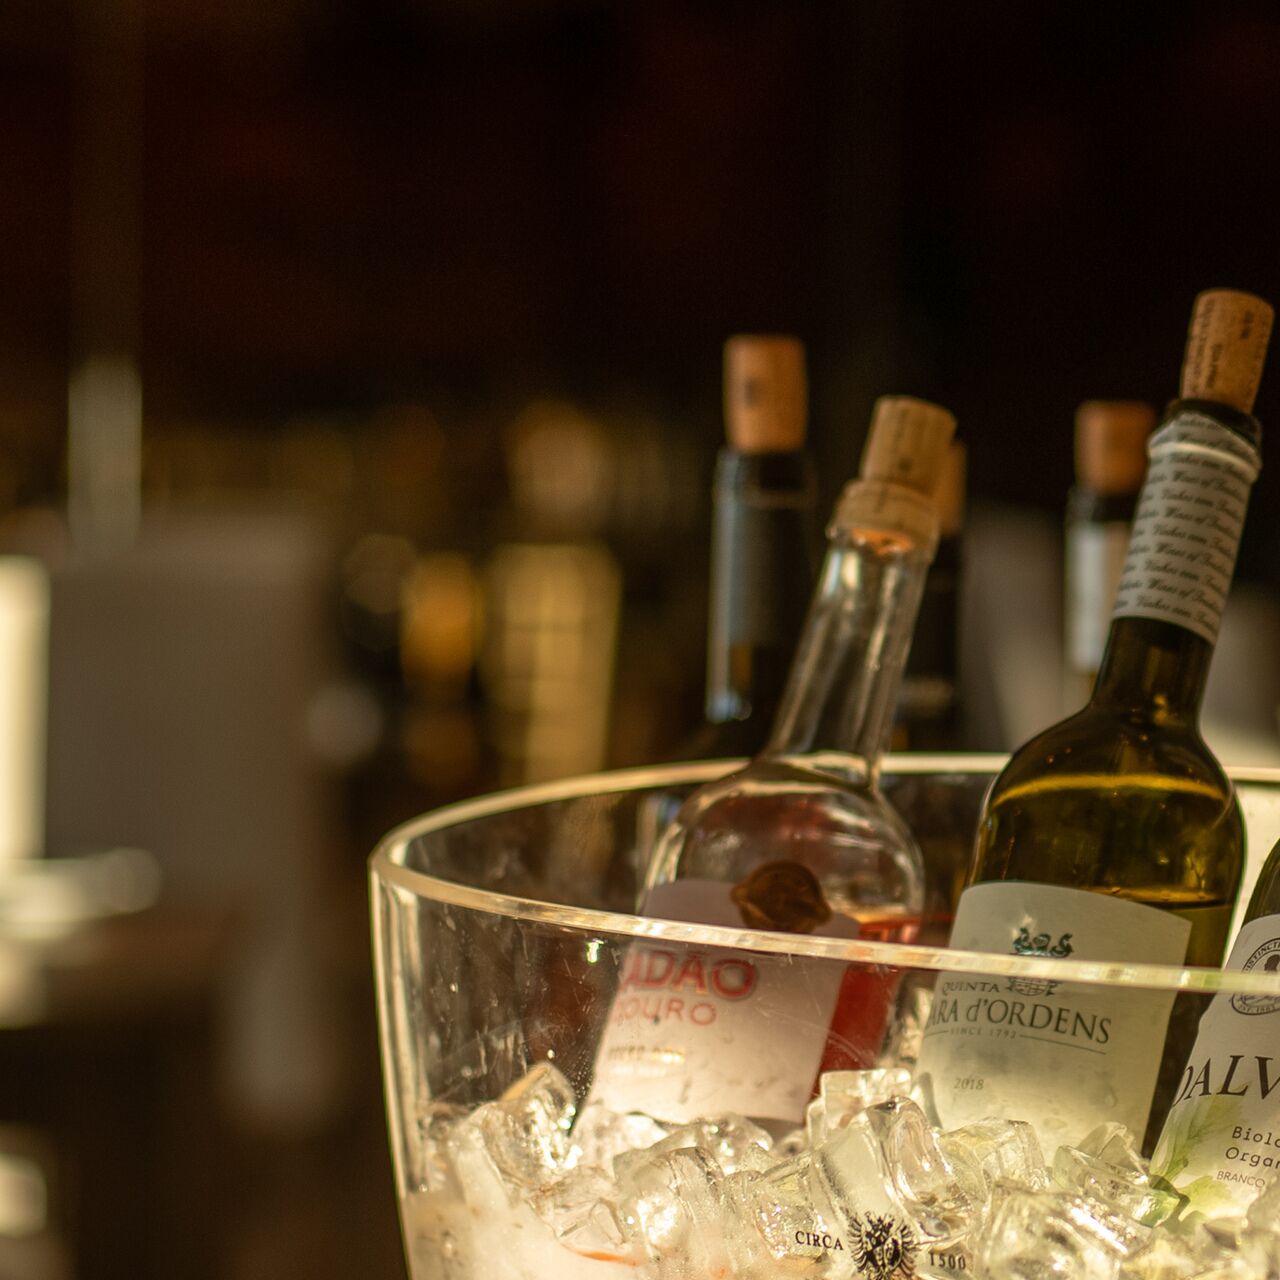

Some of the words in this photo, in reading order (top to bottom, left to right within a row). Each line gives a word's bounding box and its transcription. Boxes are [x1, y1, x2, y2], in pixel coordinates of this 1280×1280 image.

[942, 981, 1000, 996] QUINTA
[611, 995, 717, 1026] OURO
[953, 1077, 985, 1091] 2018
[1216, 1170, 1266, 1189] BRANCO
[795, 1229, 844, 1251] CIRCA
[928, 1250, 966, 1271] 1500
